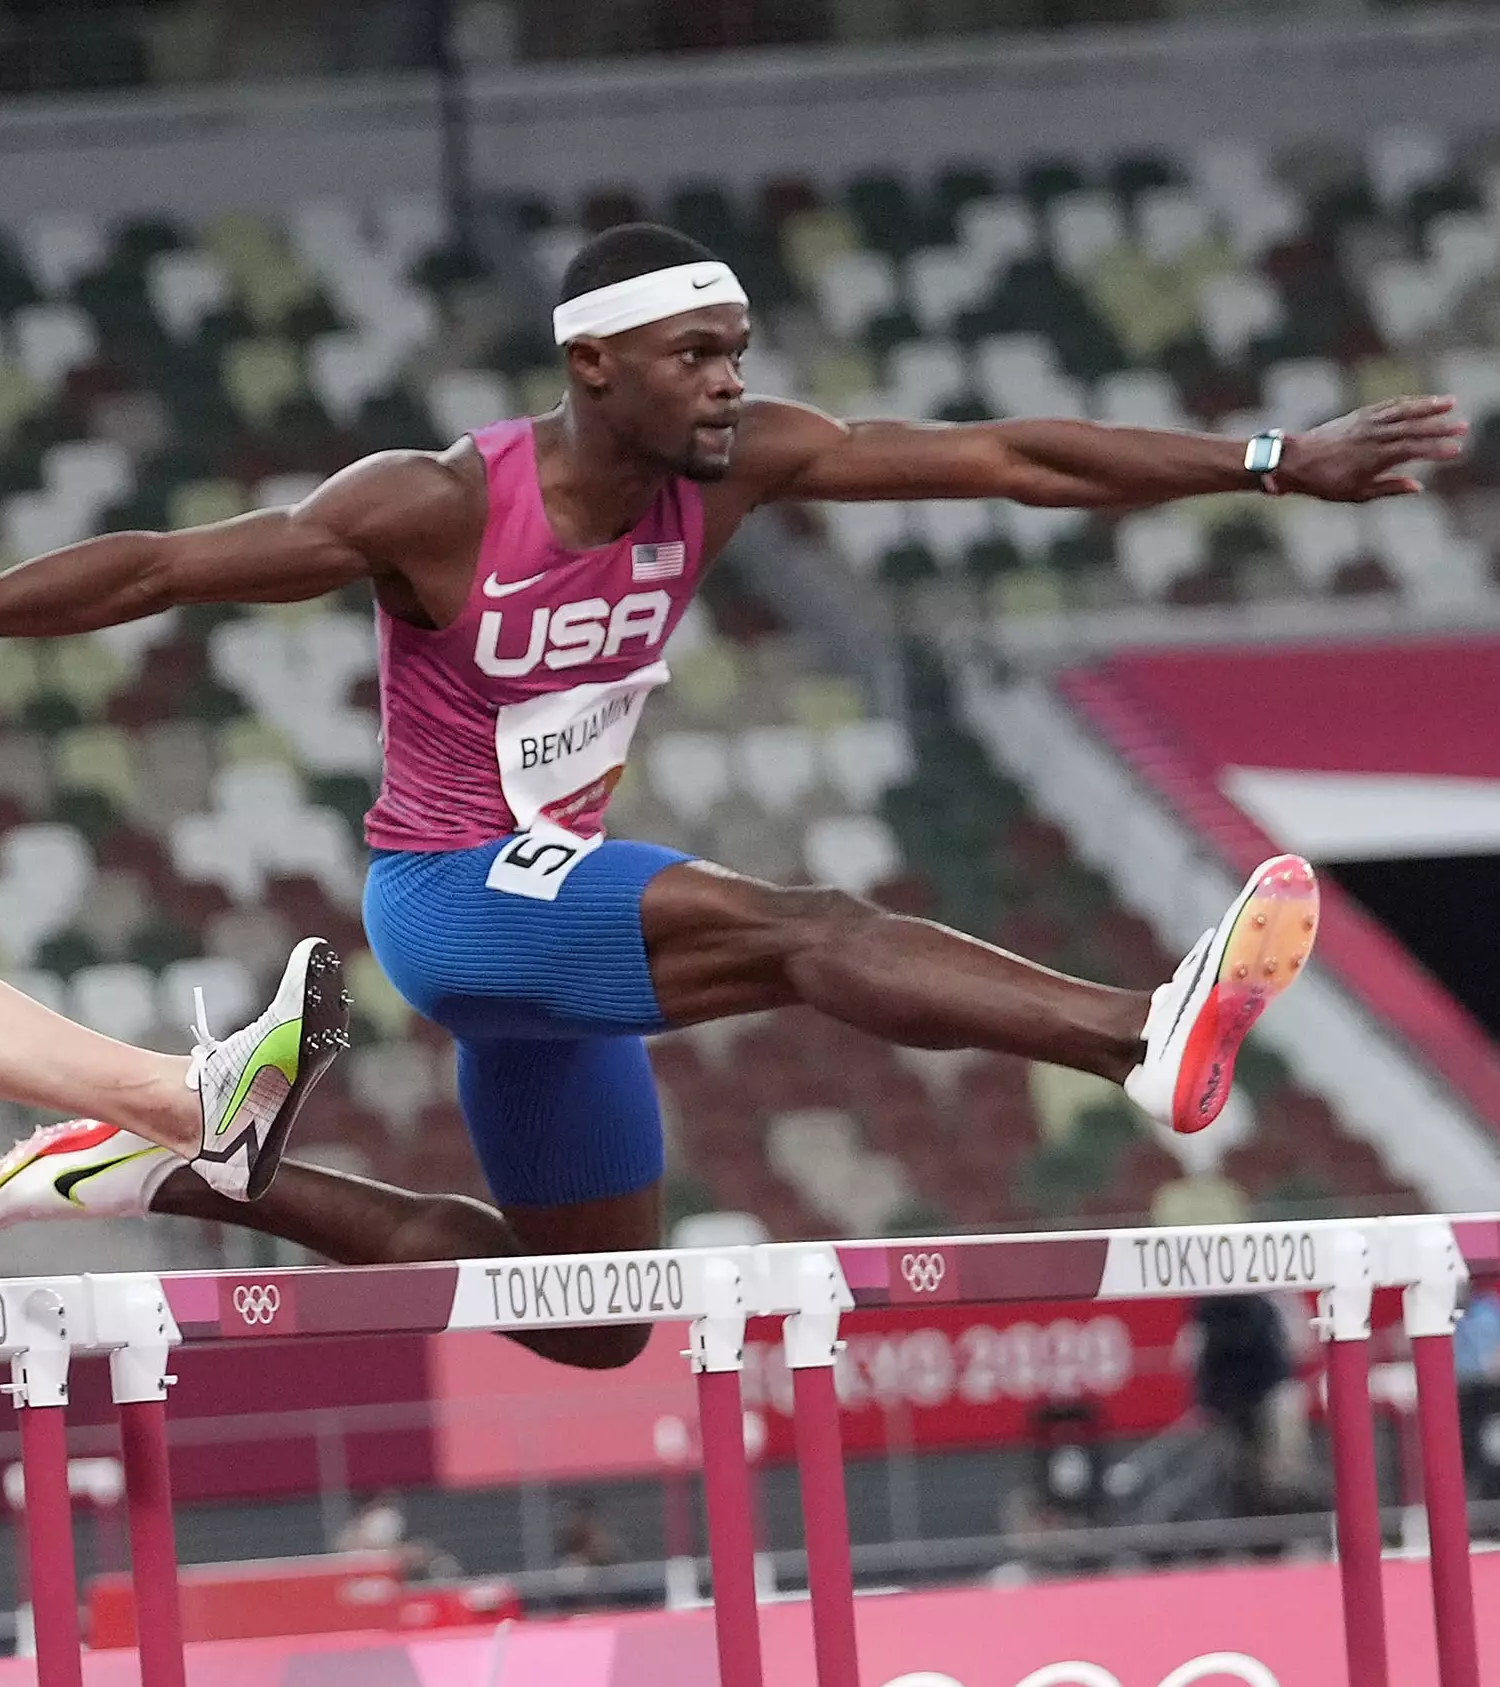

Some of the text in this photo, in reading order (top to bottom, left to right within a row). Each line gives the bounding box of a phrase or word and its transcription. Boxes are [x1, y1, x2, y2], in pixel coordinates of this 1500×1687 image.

[474, 589, 671, 678] USA
[521, 691, 638, 769] BENJAMIN
[504, 837, 577, 876] 5
[485, 1258, 683, 1320] TOKYO 2020
[1133, 1232, 1316, 1288] TOKYO 2020
